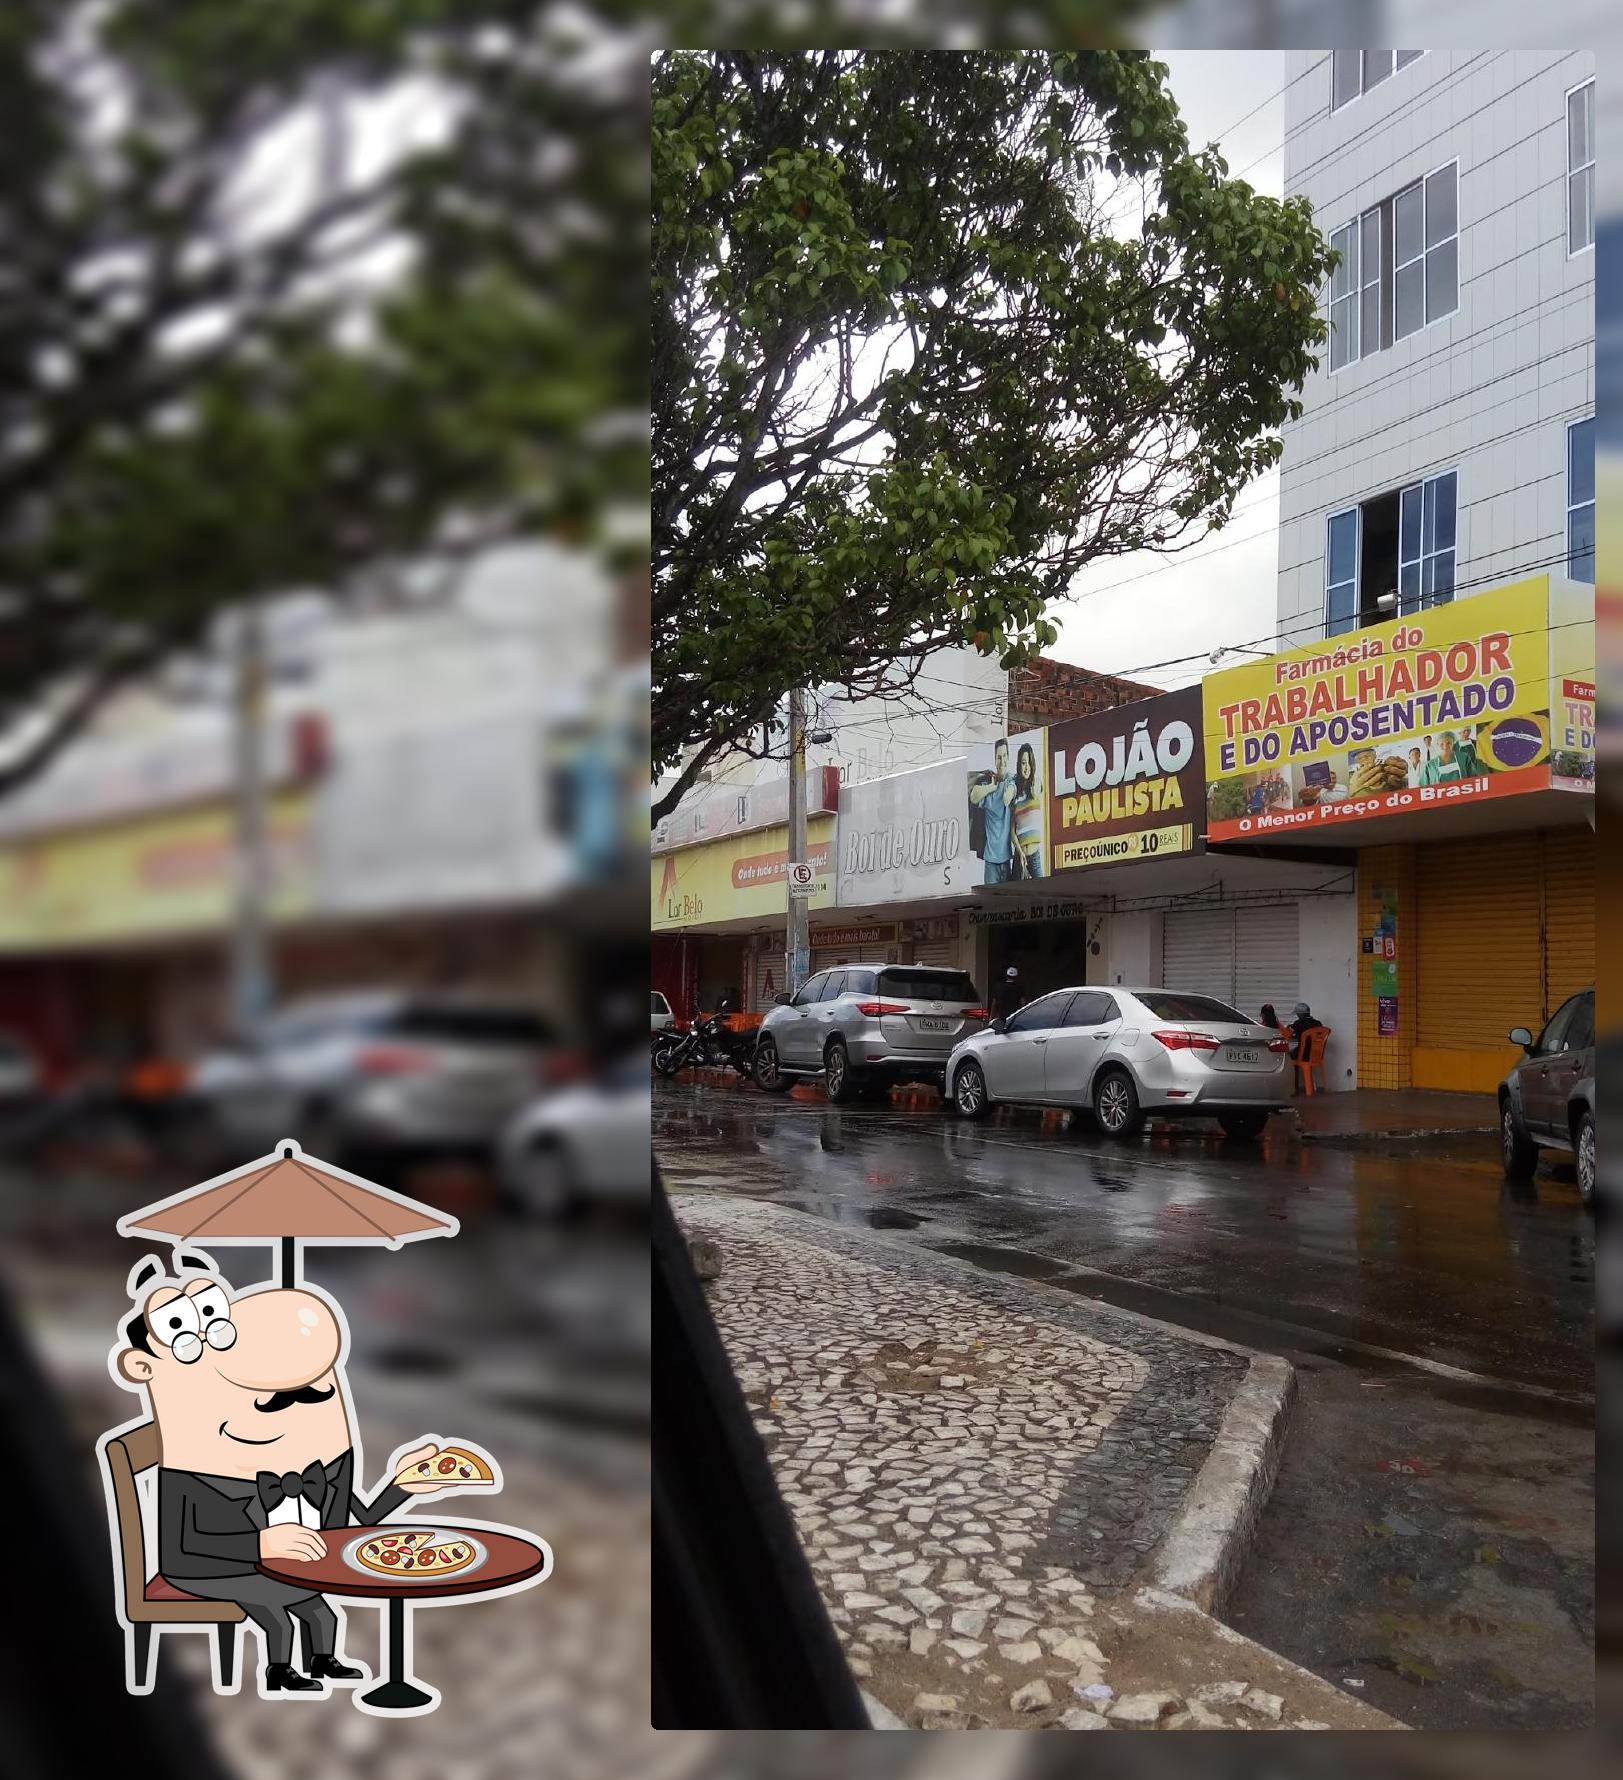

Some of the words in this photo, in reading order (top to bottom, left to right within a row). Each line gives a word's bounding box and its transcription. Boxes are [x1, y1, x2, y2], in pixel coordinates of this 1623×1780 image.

[1276, 638, 1383, 685] Farmácia
[1391, 625, 1424, 651] do
[1219, 632, 1513, 739] TRABALHADOR
[1220, 741, 1236, 771] E
[1244, 731, 1281, 766] DO
[1289, 676, 1516, 756] APOSENTADO
[1054, 717, 1194, 797] LOJÃO
[1062, 775, 1184, 829] PAULISTA
[1239, 818, 1252, 832] O
[1257, 810, 1315, 829] Menor
[1320, 799, 1380, 818] Preço
[1385, 792, 1414, 808] do
[1420, 777, 1489, 801] Brasil
[879, 822, 904, 872] de
[909, 816, 960, 867] Ouro
[1140, 832, 1159, 855] 10
[684, 892, 703, 916] Belo
